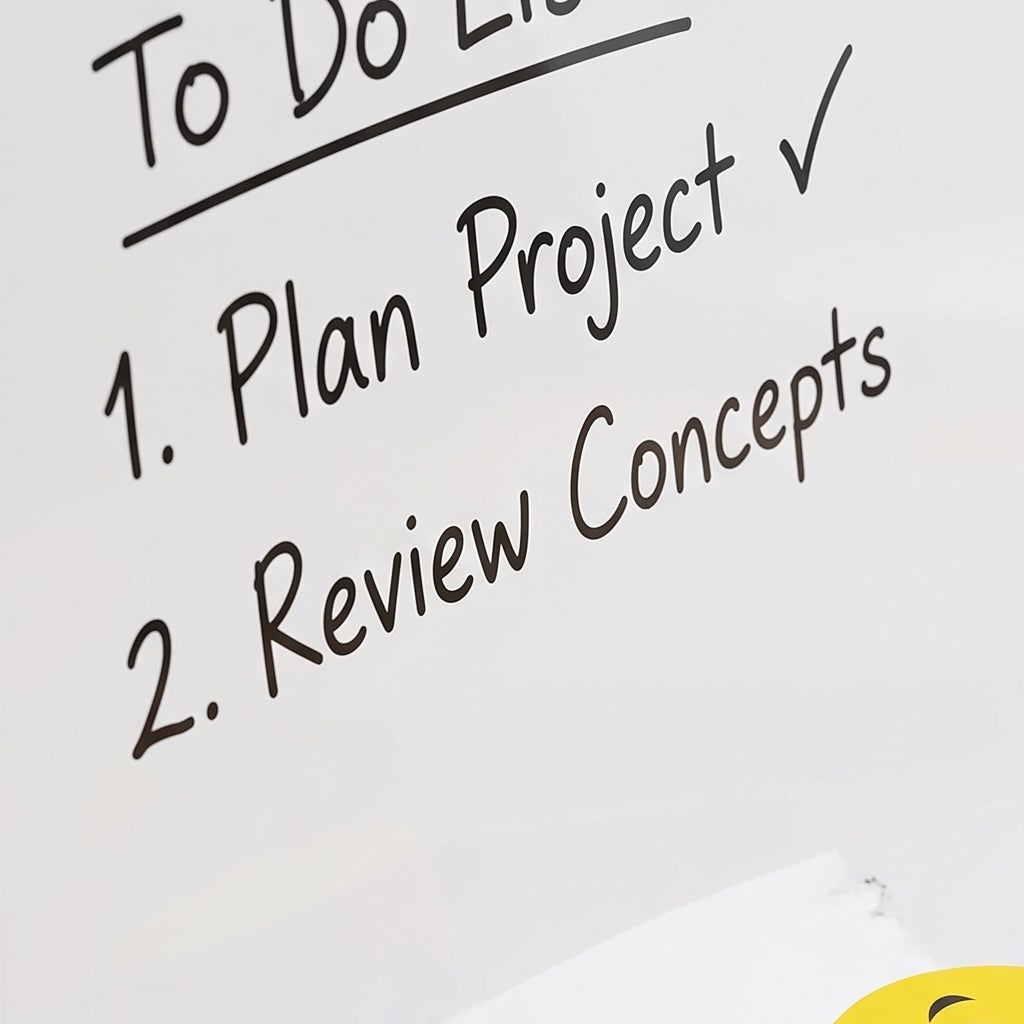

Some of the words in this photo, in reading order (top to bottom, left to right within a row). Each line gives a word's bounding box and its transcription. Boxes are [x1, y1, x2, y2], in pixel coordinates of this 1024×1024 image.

[91, 14, 230, 169] To
[270, 0, 407, 119] Do
[104, 350, 174, 480] 1.
[216, 279, 420, 446] Plan
[456, 122, 735, 341] Project
[127, 618, 219, 760] 2.
[253, 489, 530, 699] Review
[570, 307, 892, 541] Concepts
